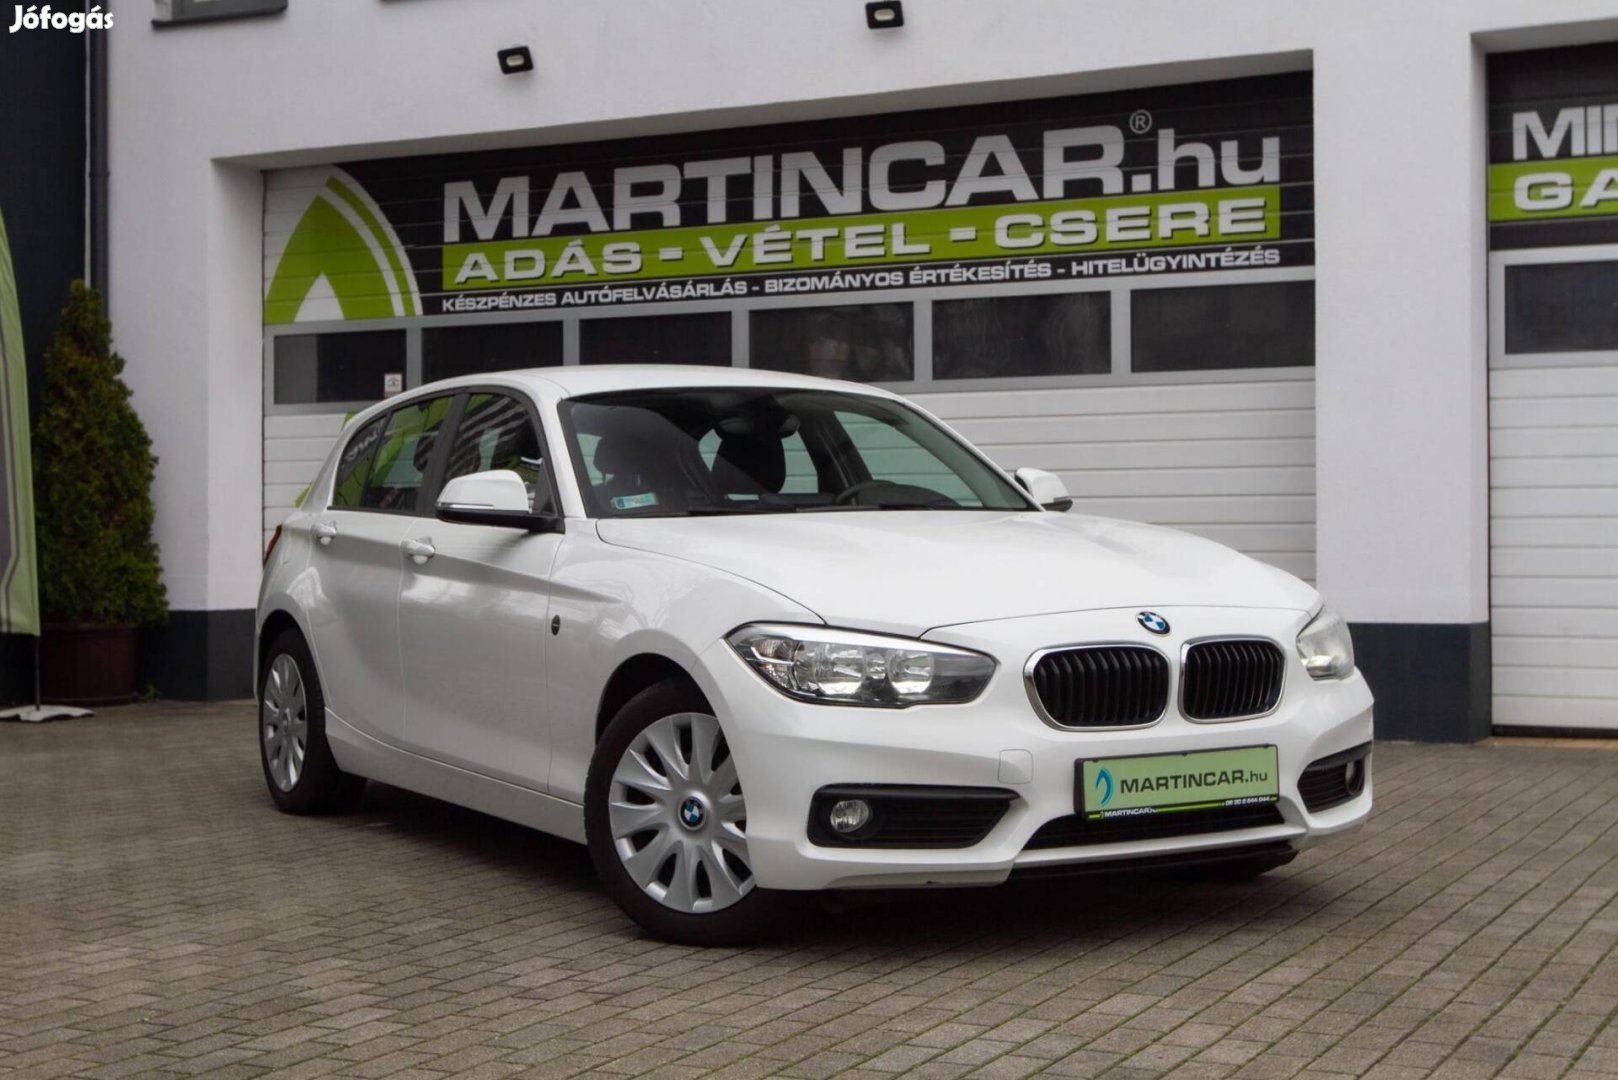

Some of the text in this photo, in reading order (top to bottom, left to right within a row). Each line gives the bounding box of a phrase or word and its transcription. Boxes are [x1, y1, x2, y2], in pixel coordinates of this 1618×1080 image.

[1512, 103, 1618, 160] MI
[454, 239, 644, 284] ADÁS
[700, 223, 931, 267] VÉTEL
[994, 198, 1266, 249] CSERE
[442, 292, 556, 312] KÉSZPÉNZES
[561, 278, 748, 305] AUTÓFELVÁSÁRLÁS
[765, 271, 904, 293] BIZOMÁNYOS
[909, 260, 1051, 285] ÉRTÉKESÍTÉS
[1071, 245, 1280, 276] HITELÜGYINTÉZÉS
[1120, 769, 1268, 794] MARTINCAR.hu
